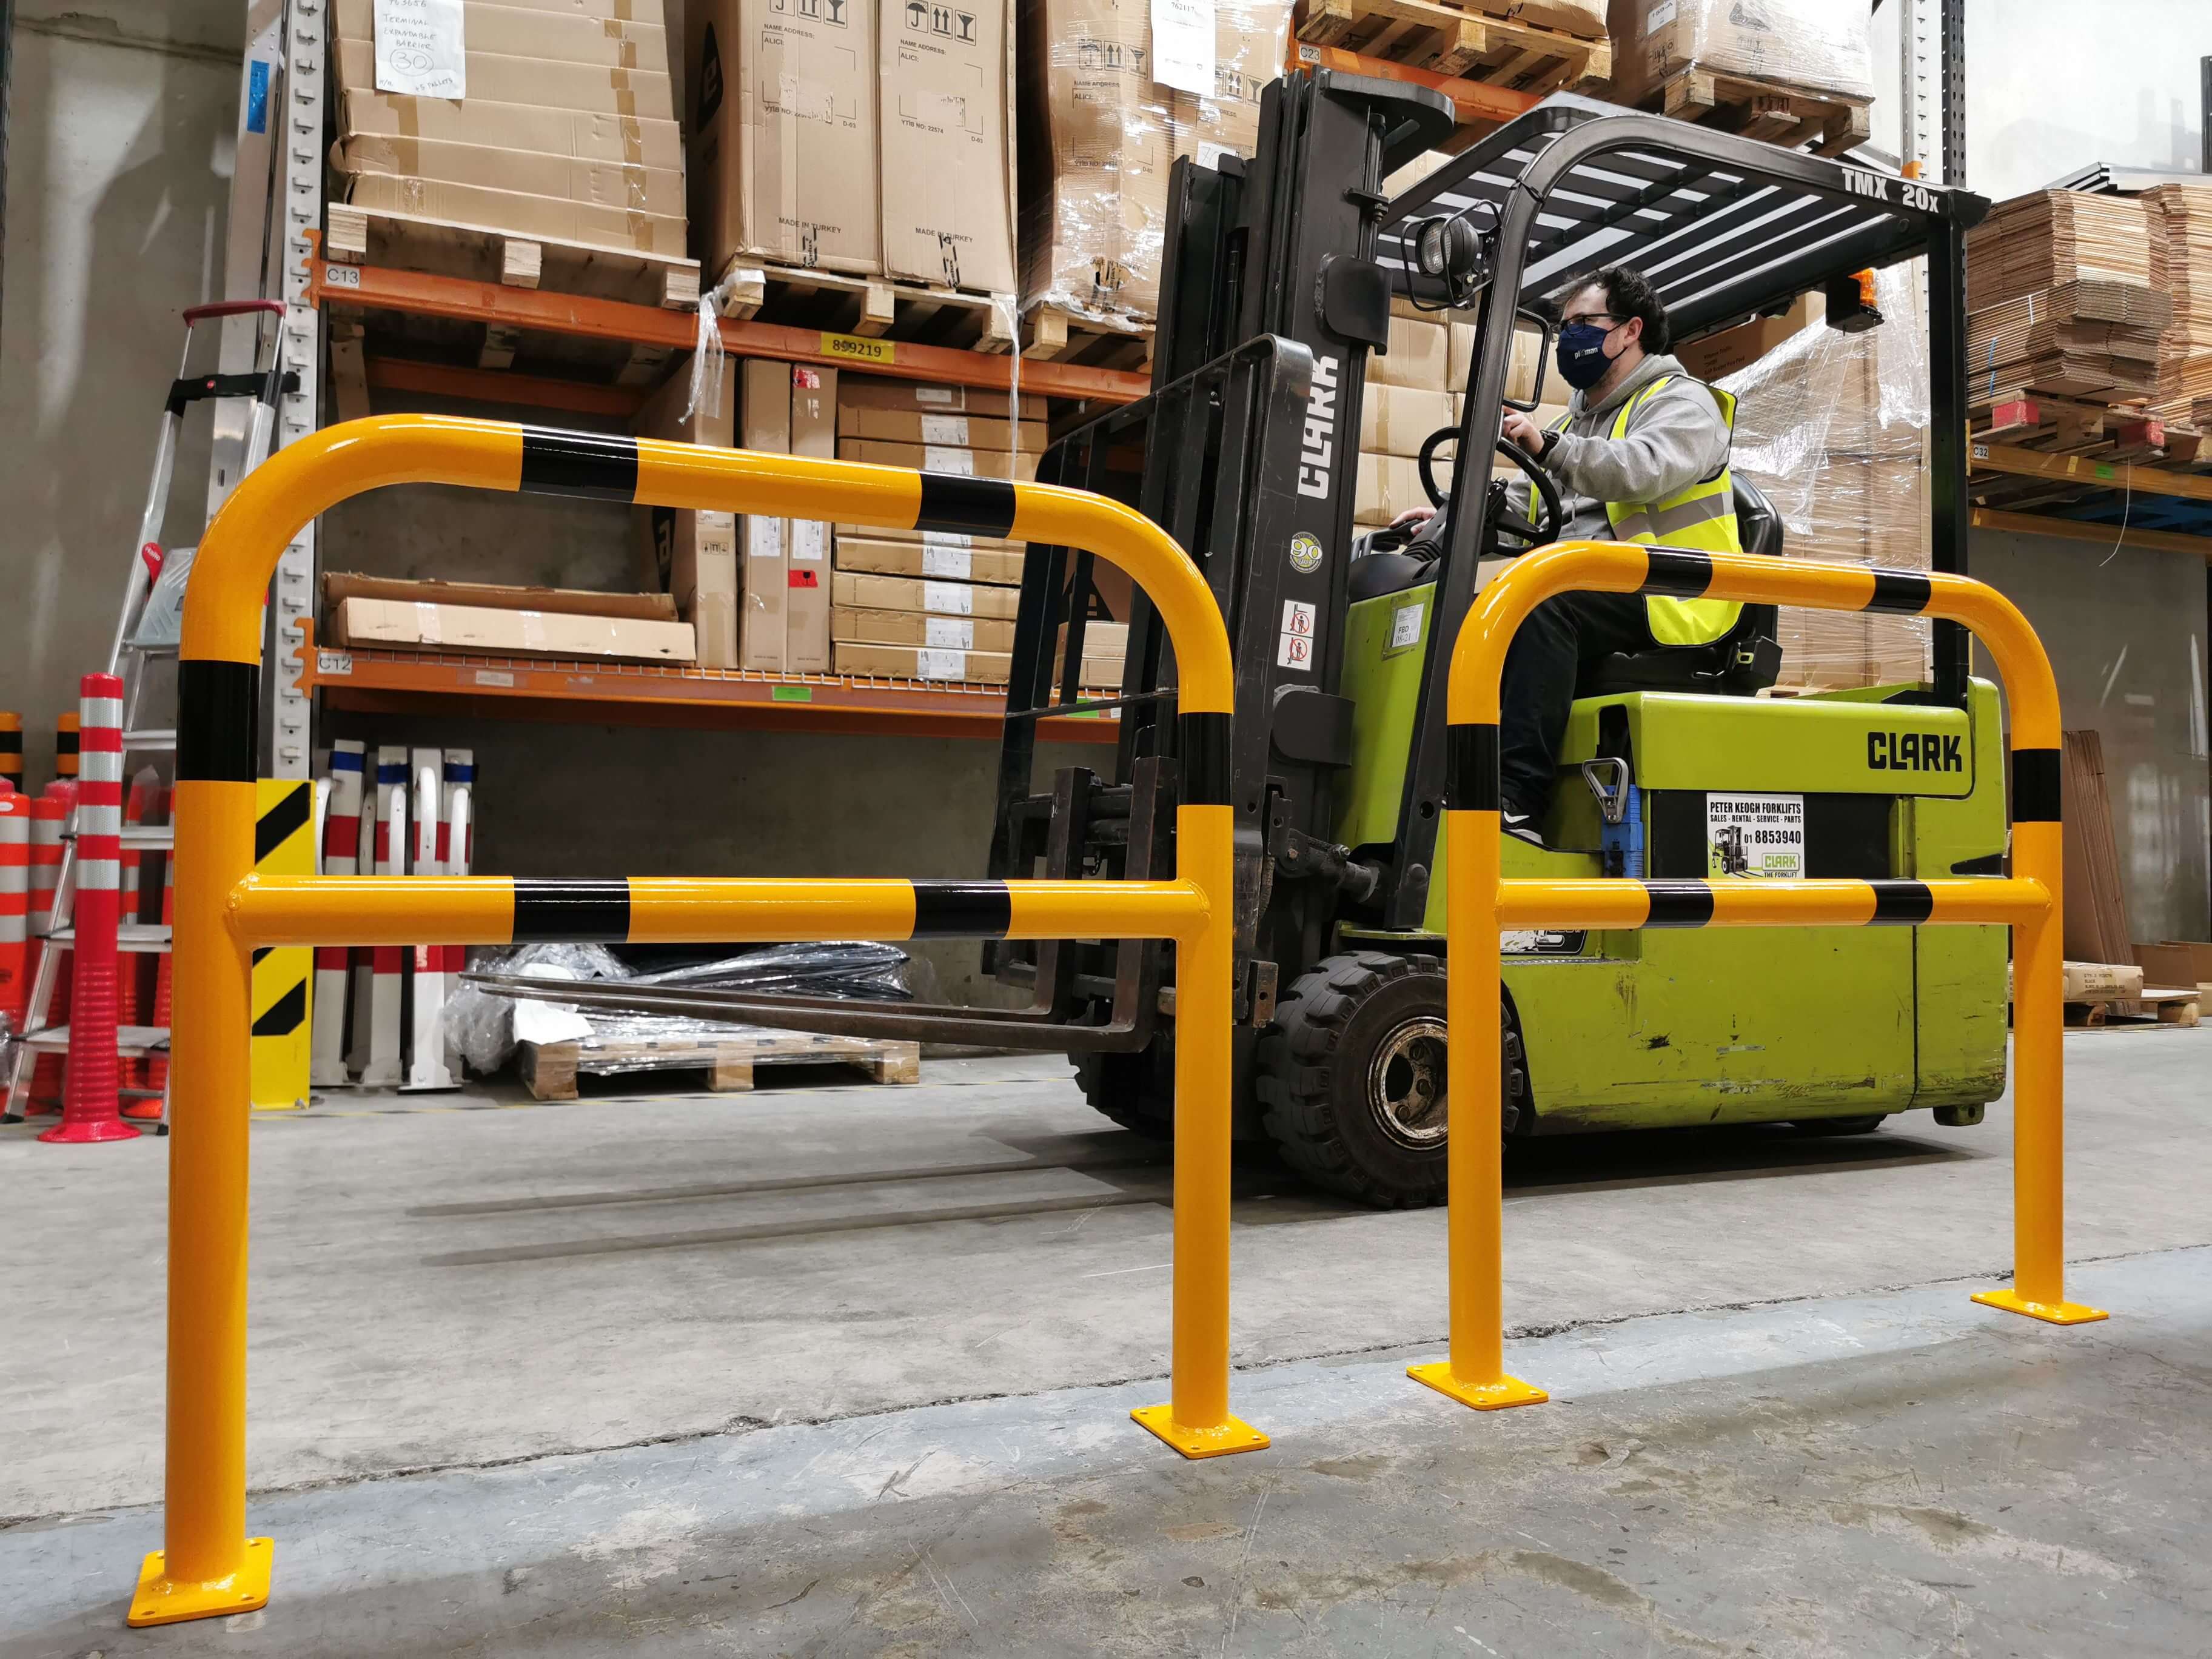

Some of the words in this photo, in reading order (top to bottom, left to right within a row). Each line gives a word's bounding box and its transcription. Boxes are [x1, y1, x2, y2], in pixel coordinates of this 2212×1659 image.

[1171, 2, 1195, 13] 762117
[383, 13, 429, 26] TERMINAL
[784, 27, 815, 39] ADDRESS:
[900, 39, 917, 47] NAME
[918, 44, 947, 55] ADDRESS:
[1301, 47, 1319, 60] C23
[396, 52, 427, 69] 30
[916, 121, 927, 130] NO:
[928, 126, 943, 134] 22574
[1842, 167, 1889, 201] TMX
[779, 217, 800, 227] MADE
[811, 223, 842, 233] TURKEY
[916, 227, 936, 236] MADE
[945, 233, 973, 243] TURKEY
[327, 268, 358, 284] C13
[1297, 356, 1339, 500] CLARK
[1974, 447, 1988, 456] C32
[1291, 538, 1322, 560] 90
[1398, 625, 1409, 634] FBD
[1395, 632, 1411, 643] 08-21
[320, 658, 350, 671] C12
[1868, 732, 1962, 772] CLARK
[1710, 802, 1733, 813] PETER
[1735, 802, 1760, 813] KEOGH
[1762, 803, 1801, 814] FORKLIFTS
[1744, 834, 1752, 843] 01
[1755, 830, 1801, 844] 8853940
[1765, 856, 1796, 868] CLARK
